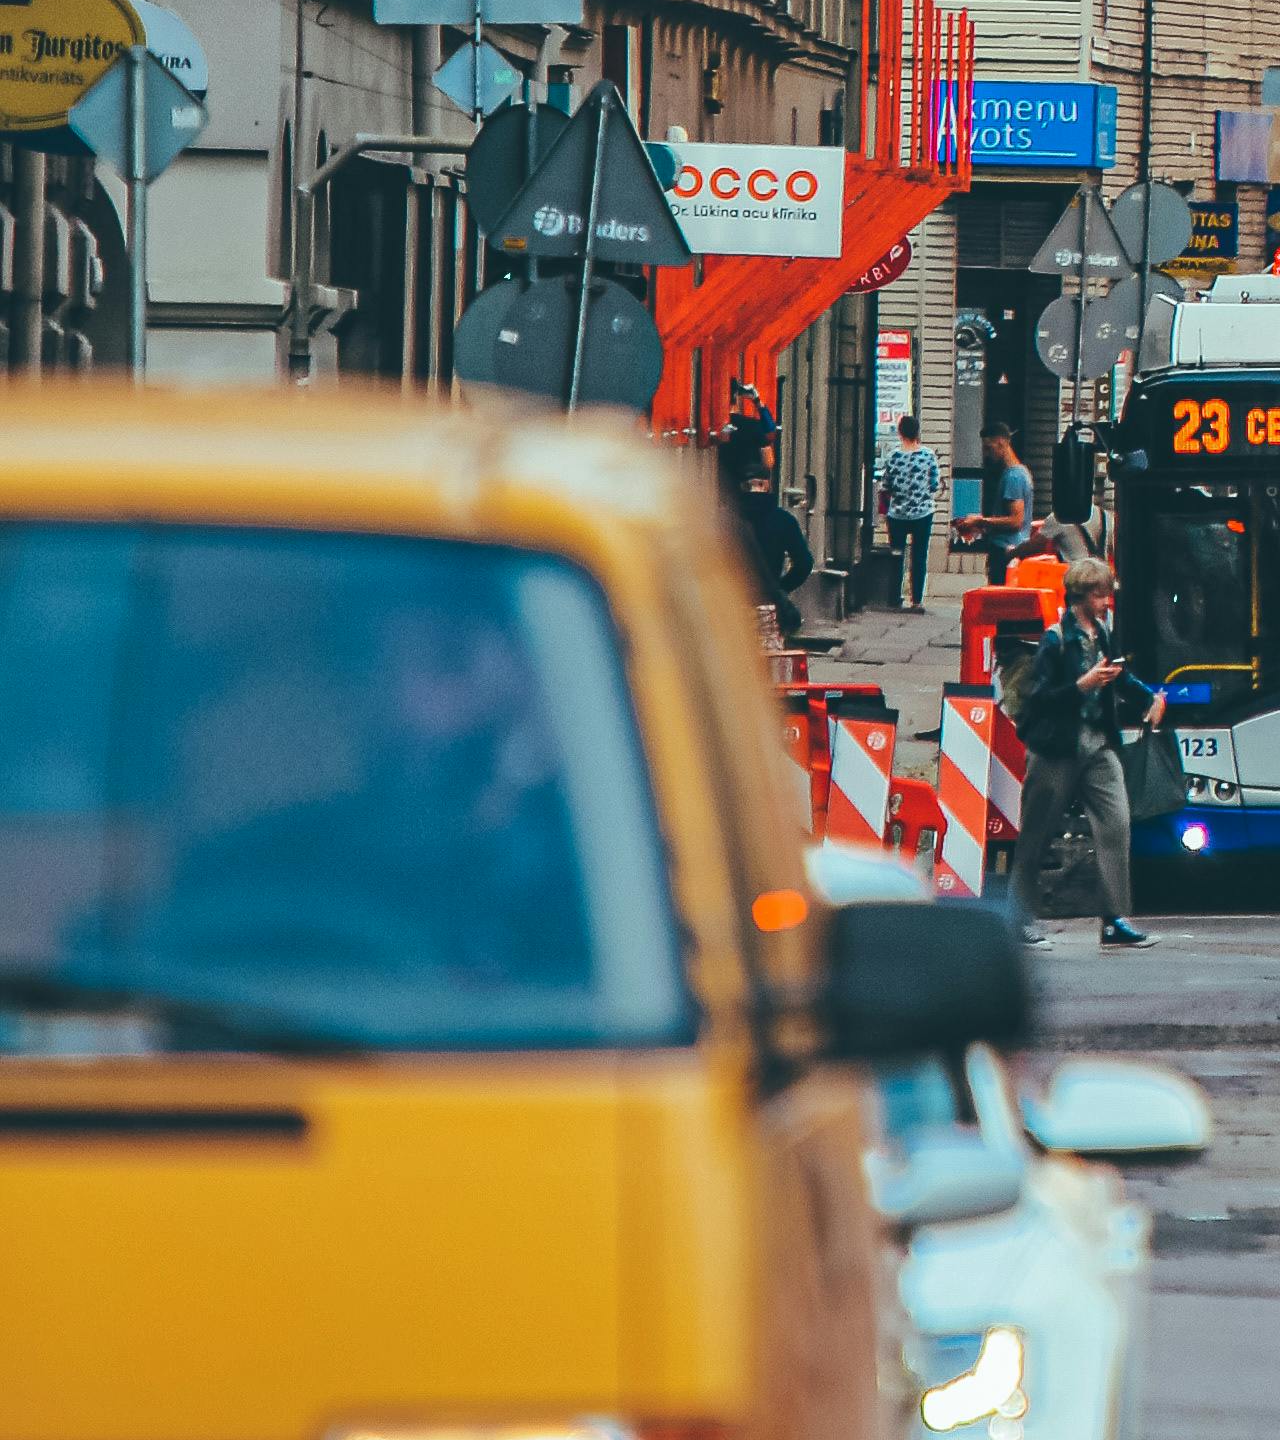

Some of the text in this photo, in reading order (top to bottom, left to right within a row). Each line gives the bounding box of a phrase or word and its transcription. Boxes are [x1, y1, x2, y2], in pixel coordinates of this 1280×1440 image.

[694, 204, 738, 218] Lūkina
[742, 209, 768, 219] acu
[1174, 398, 1230, 454] 23
[1180, 737, 1218, 757] 123
